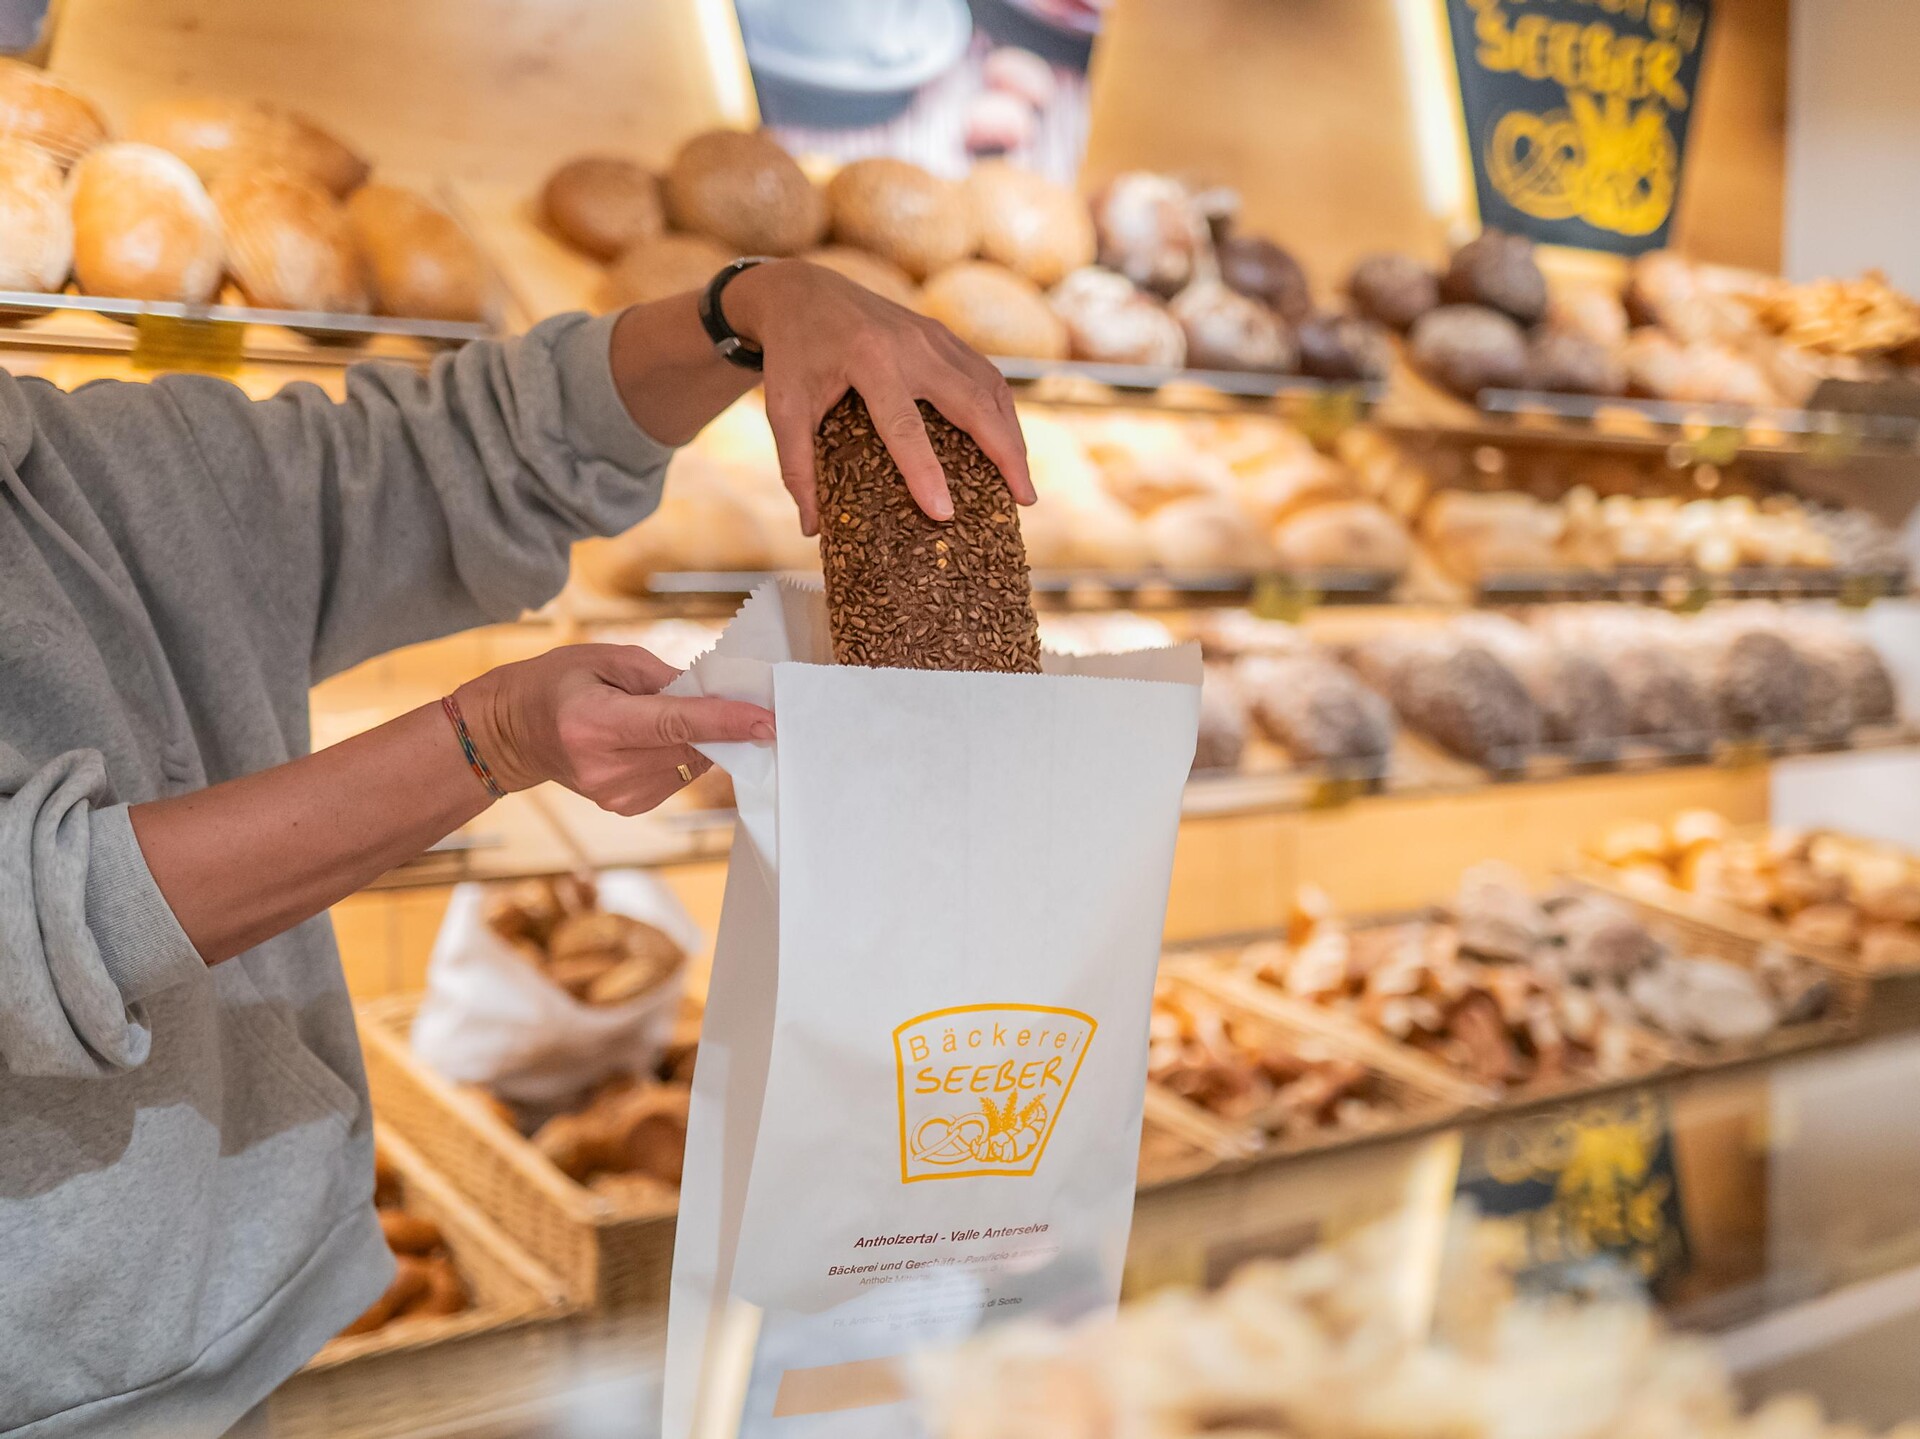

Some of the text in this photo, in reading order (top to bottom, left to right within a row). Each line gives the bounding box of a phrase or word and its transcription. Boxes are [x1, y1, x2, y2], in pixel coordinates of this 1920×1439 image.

[908, 1022, 1083, 1062] Bäckerei
[914, 1055, 1062, 1094] SEEBER
[853, 1232, 939, 1248] Antholzertal
[951, 1229, 980, 1242] Valle
[982, 1223, 1049, 1239] Anterselva
[828, 1262, 879, 1276] Bäckerei
[880, 1260, 903, 1271] und
[859, 1275, 893, 1286] Antholz
